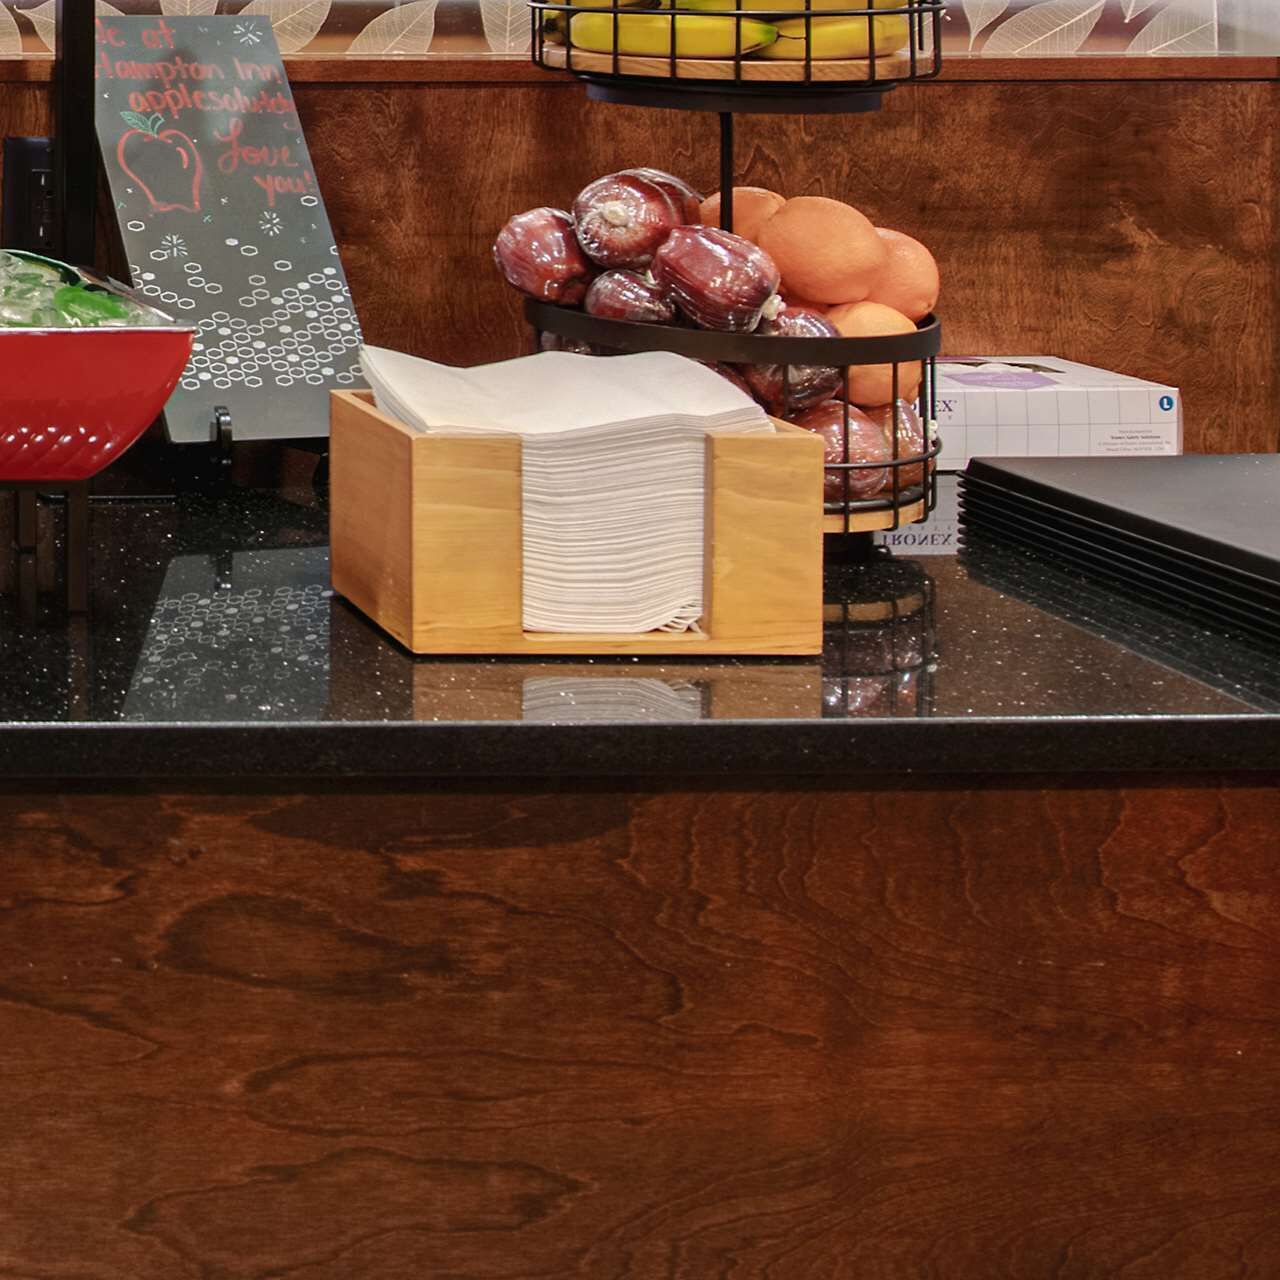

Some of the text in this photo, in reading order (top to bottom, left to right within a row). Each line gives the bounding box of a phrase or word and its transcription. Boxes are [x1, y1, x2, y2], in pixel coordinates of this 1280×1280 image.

[142, 20, 176, 48] at
[95, 52, 283, 88] Hampton Inn
